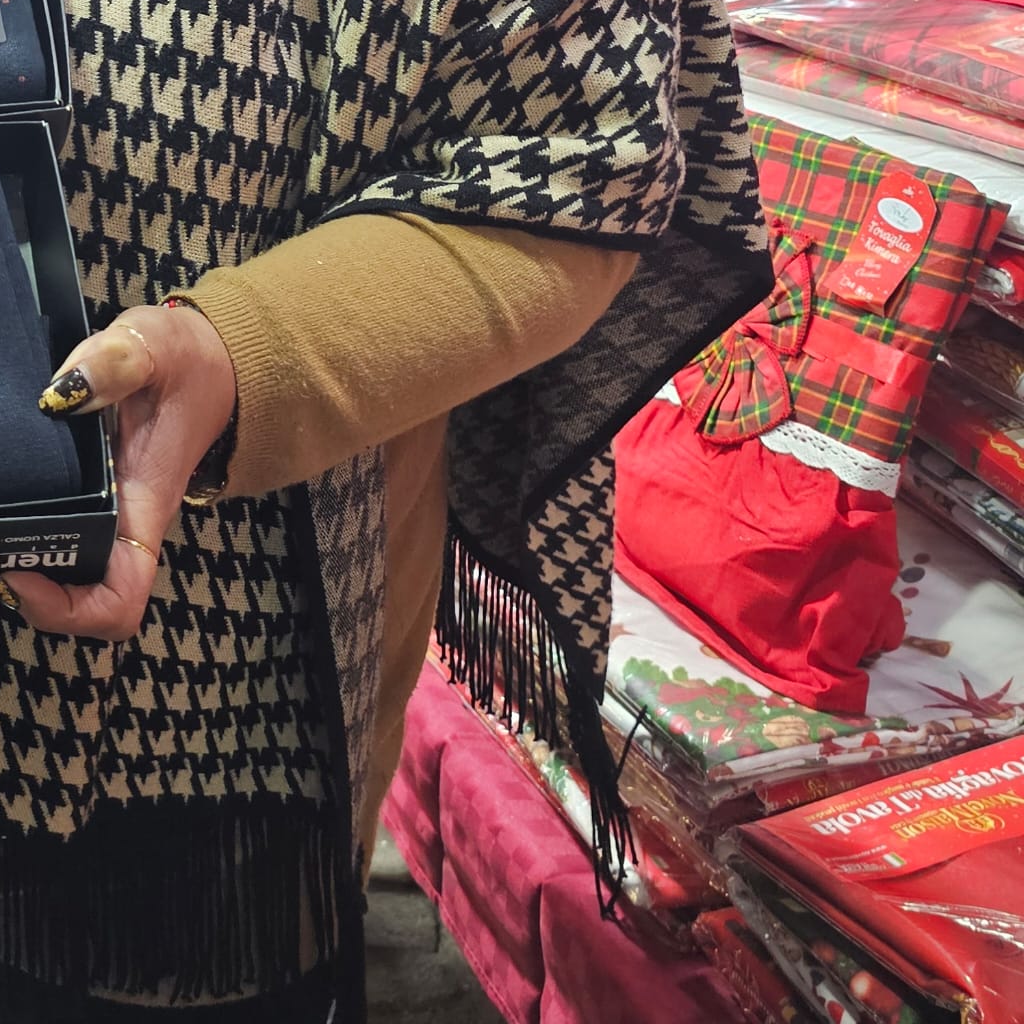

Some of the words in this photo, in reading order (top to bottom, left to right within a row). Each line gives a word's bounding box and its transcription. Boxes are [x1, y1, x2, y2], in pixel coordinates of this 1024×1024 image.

[868, 220, 912, 253] Tovaglia
[5, 535, 41, 543] UOMO
[42, 533, 80, 541] CALZA
[922, 759, 1024, 801] ovaglia
